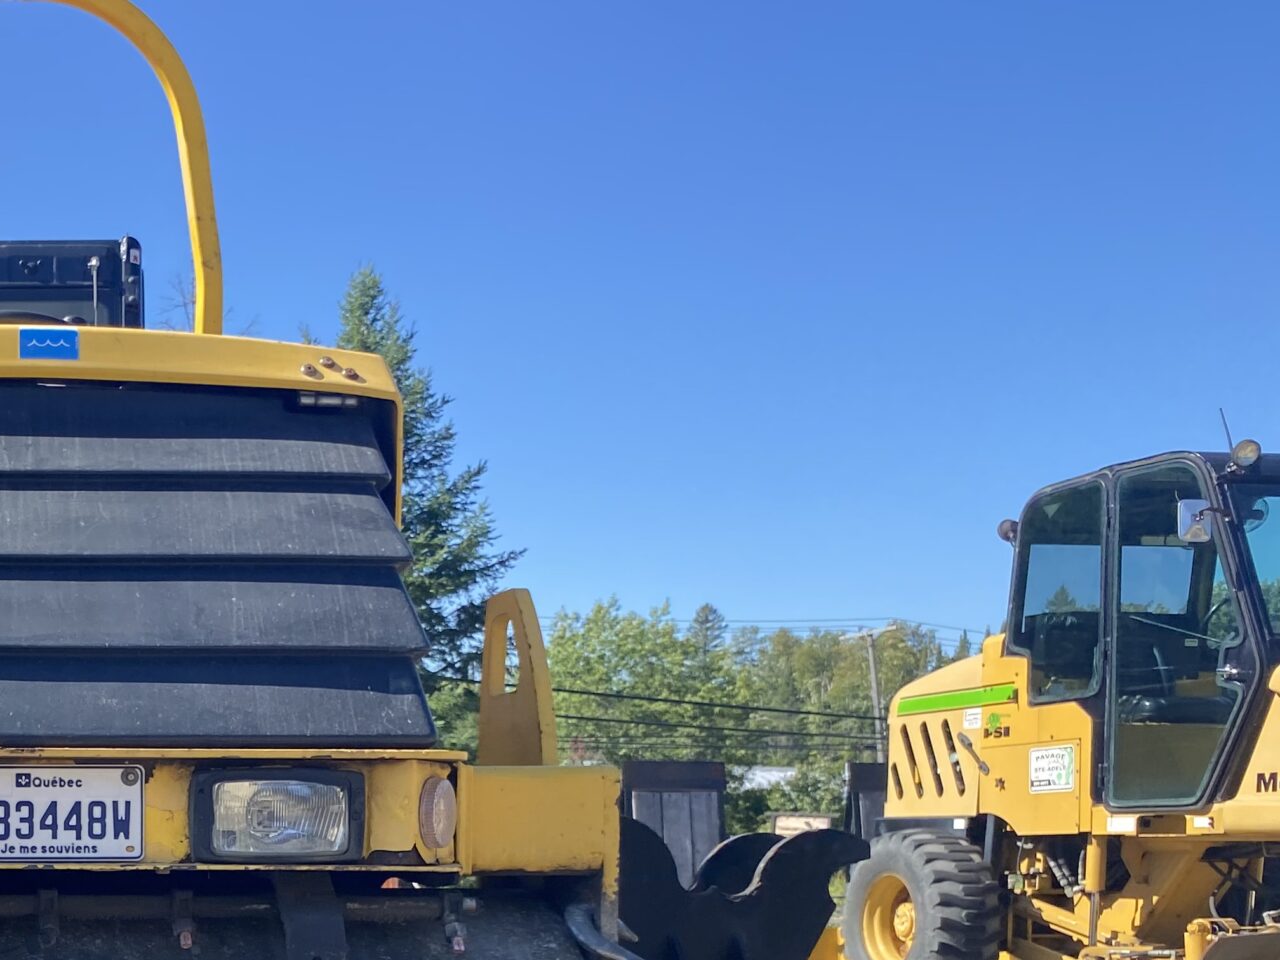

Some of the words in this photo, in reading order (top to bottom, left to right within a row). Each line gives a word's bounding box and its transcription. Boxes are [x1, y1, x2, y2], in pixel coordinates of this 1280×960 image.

[32, 776, 83, 788] Québec
[0, 844, 16, 854] Je
[20, 845, 37, 854] me
[41, 843, 98, 854] souviens
